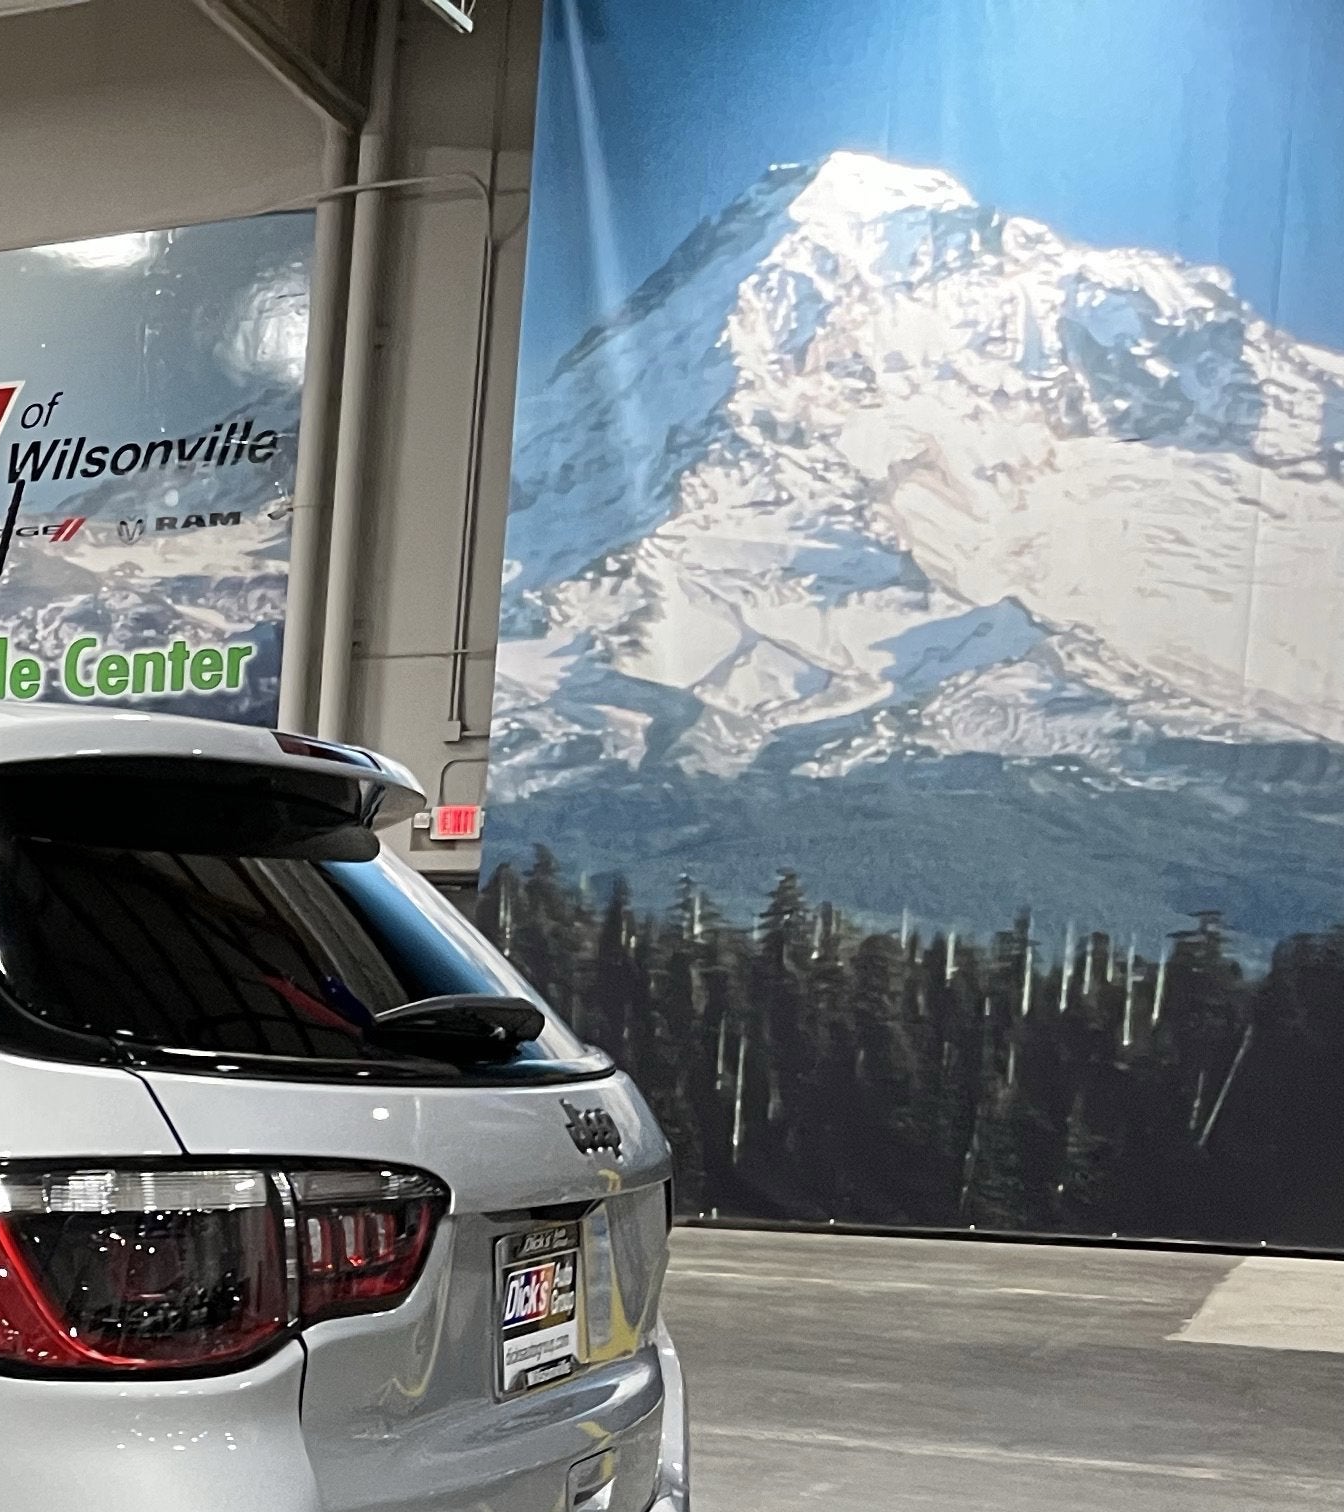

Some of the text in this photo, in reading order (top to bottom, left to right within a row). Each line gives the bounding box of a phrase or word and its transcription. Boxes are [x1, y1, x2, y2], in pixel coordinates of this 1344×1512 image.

[20, 391, 64, 429] of
[7, 419, 278, 484] Wilsonville
[155, 511, 242, 531] RAM
[64, 637, 254, 697] Center
